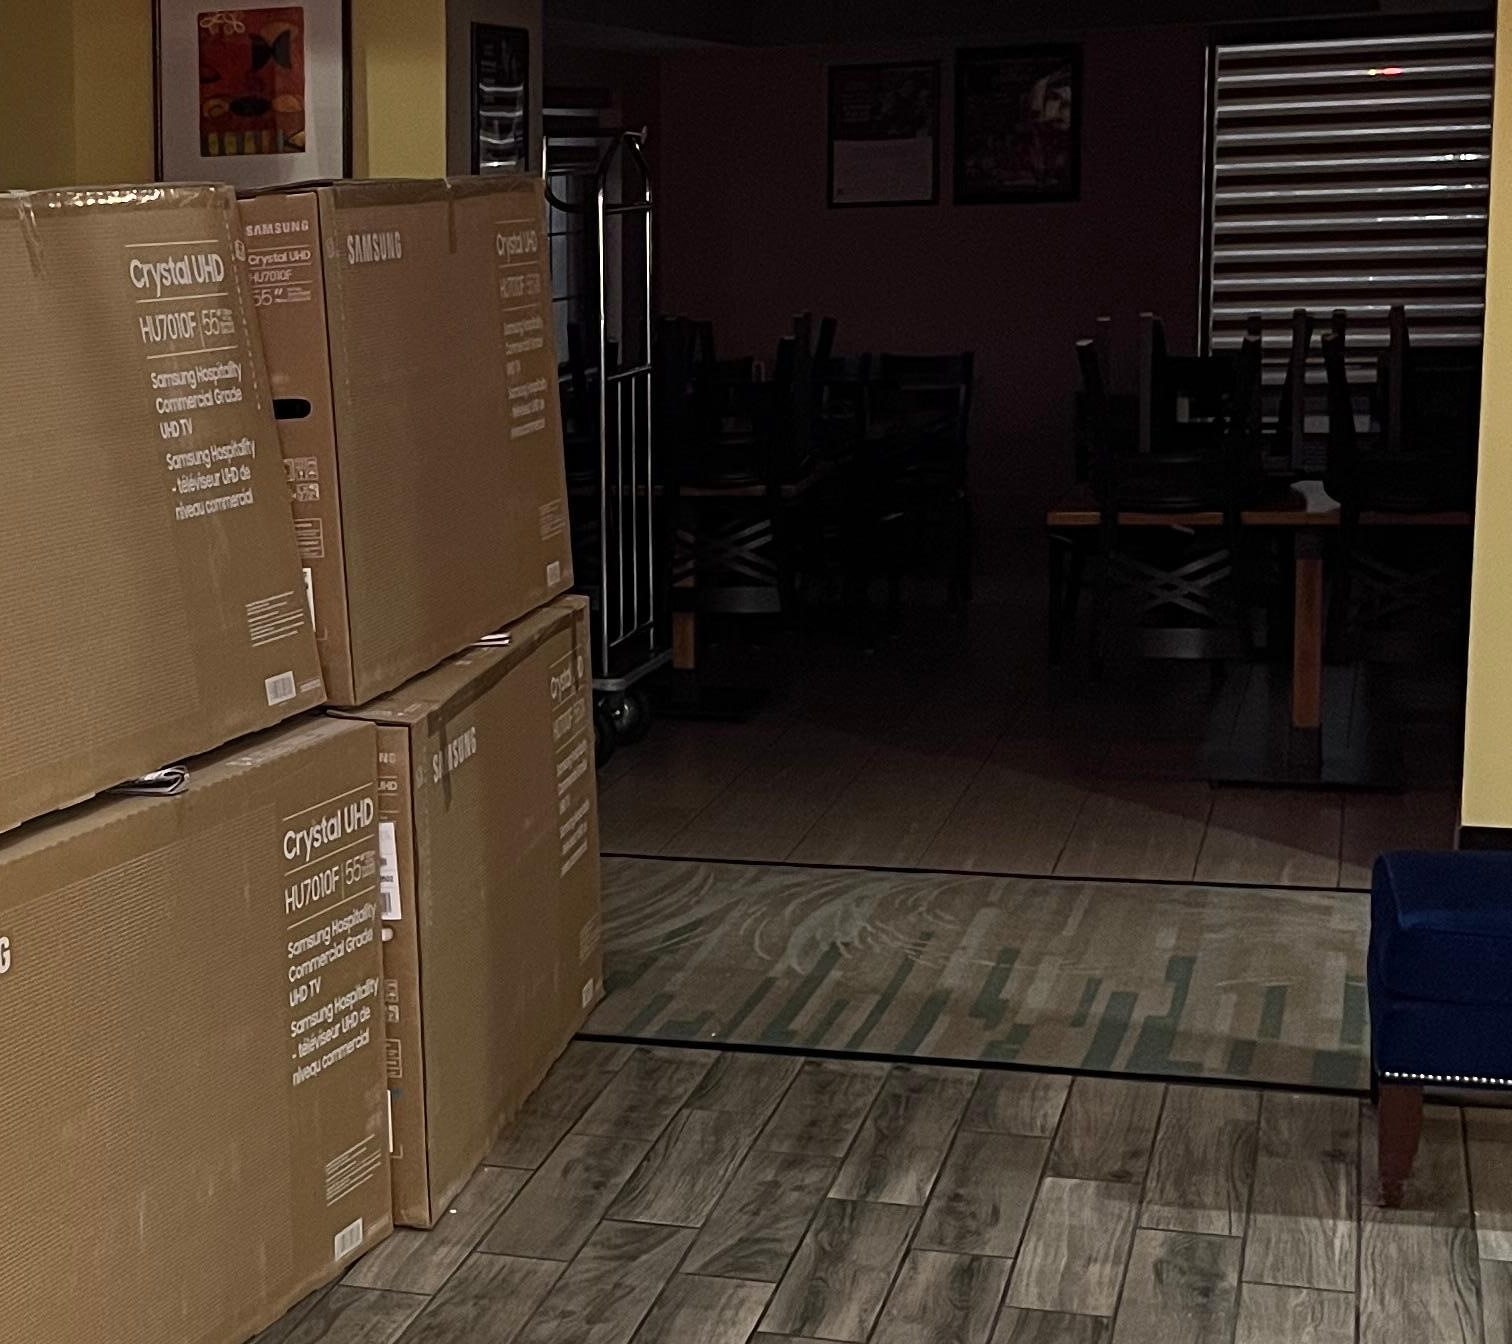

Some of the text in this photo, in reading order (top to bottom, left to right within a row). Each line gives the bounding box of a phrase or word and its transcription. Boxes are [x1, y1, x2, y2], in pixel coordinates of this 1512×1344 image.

[246, 220, 309, 237] SAMSUNG
[248, 249, 311, 268] Crystal UHD
[347, 231, 402, 265] SAMSUNG
[130, 253, 224, 297] Crystal UHD
[139, 311, 197, 344] HU7010F
[151, 360, 242, 389] Samsung Hospitality
[156, 386, 242, 414] Commercial Grade
[160, 418, 193, 439] UHD TV
[166, 437, 256, 471] Samsung Hospitality
[221, 466, 239, 485] UHD
[239, 464, 251, 481] de
[176, 488, 254, 520] niveau commercial
[283, 797, 374, 862] Crystal UHD
[284, 865, 340, 915] HU7010F
[287, 902, 377, 959] Samsung Hospitality
[288, 927, 373, 983] Commercial Grade
[289, 975, 321, 1007] UHD TV
[291, 975, 380, 1038] Samsung Hospitality
[341, 1011, 359, 1034] UHD
[359, 1006, 371, 1023] de
[321, 1027, 370, 1070] commercial
